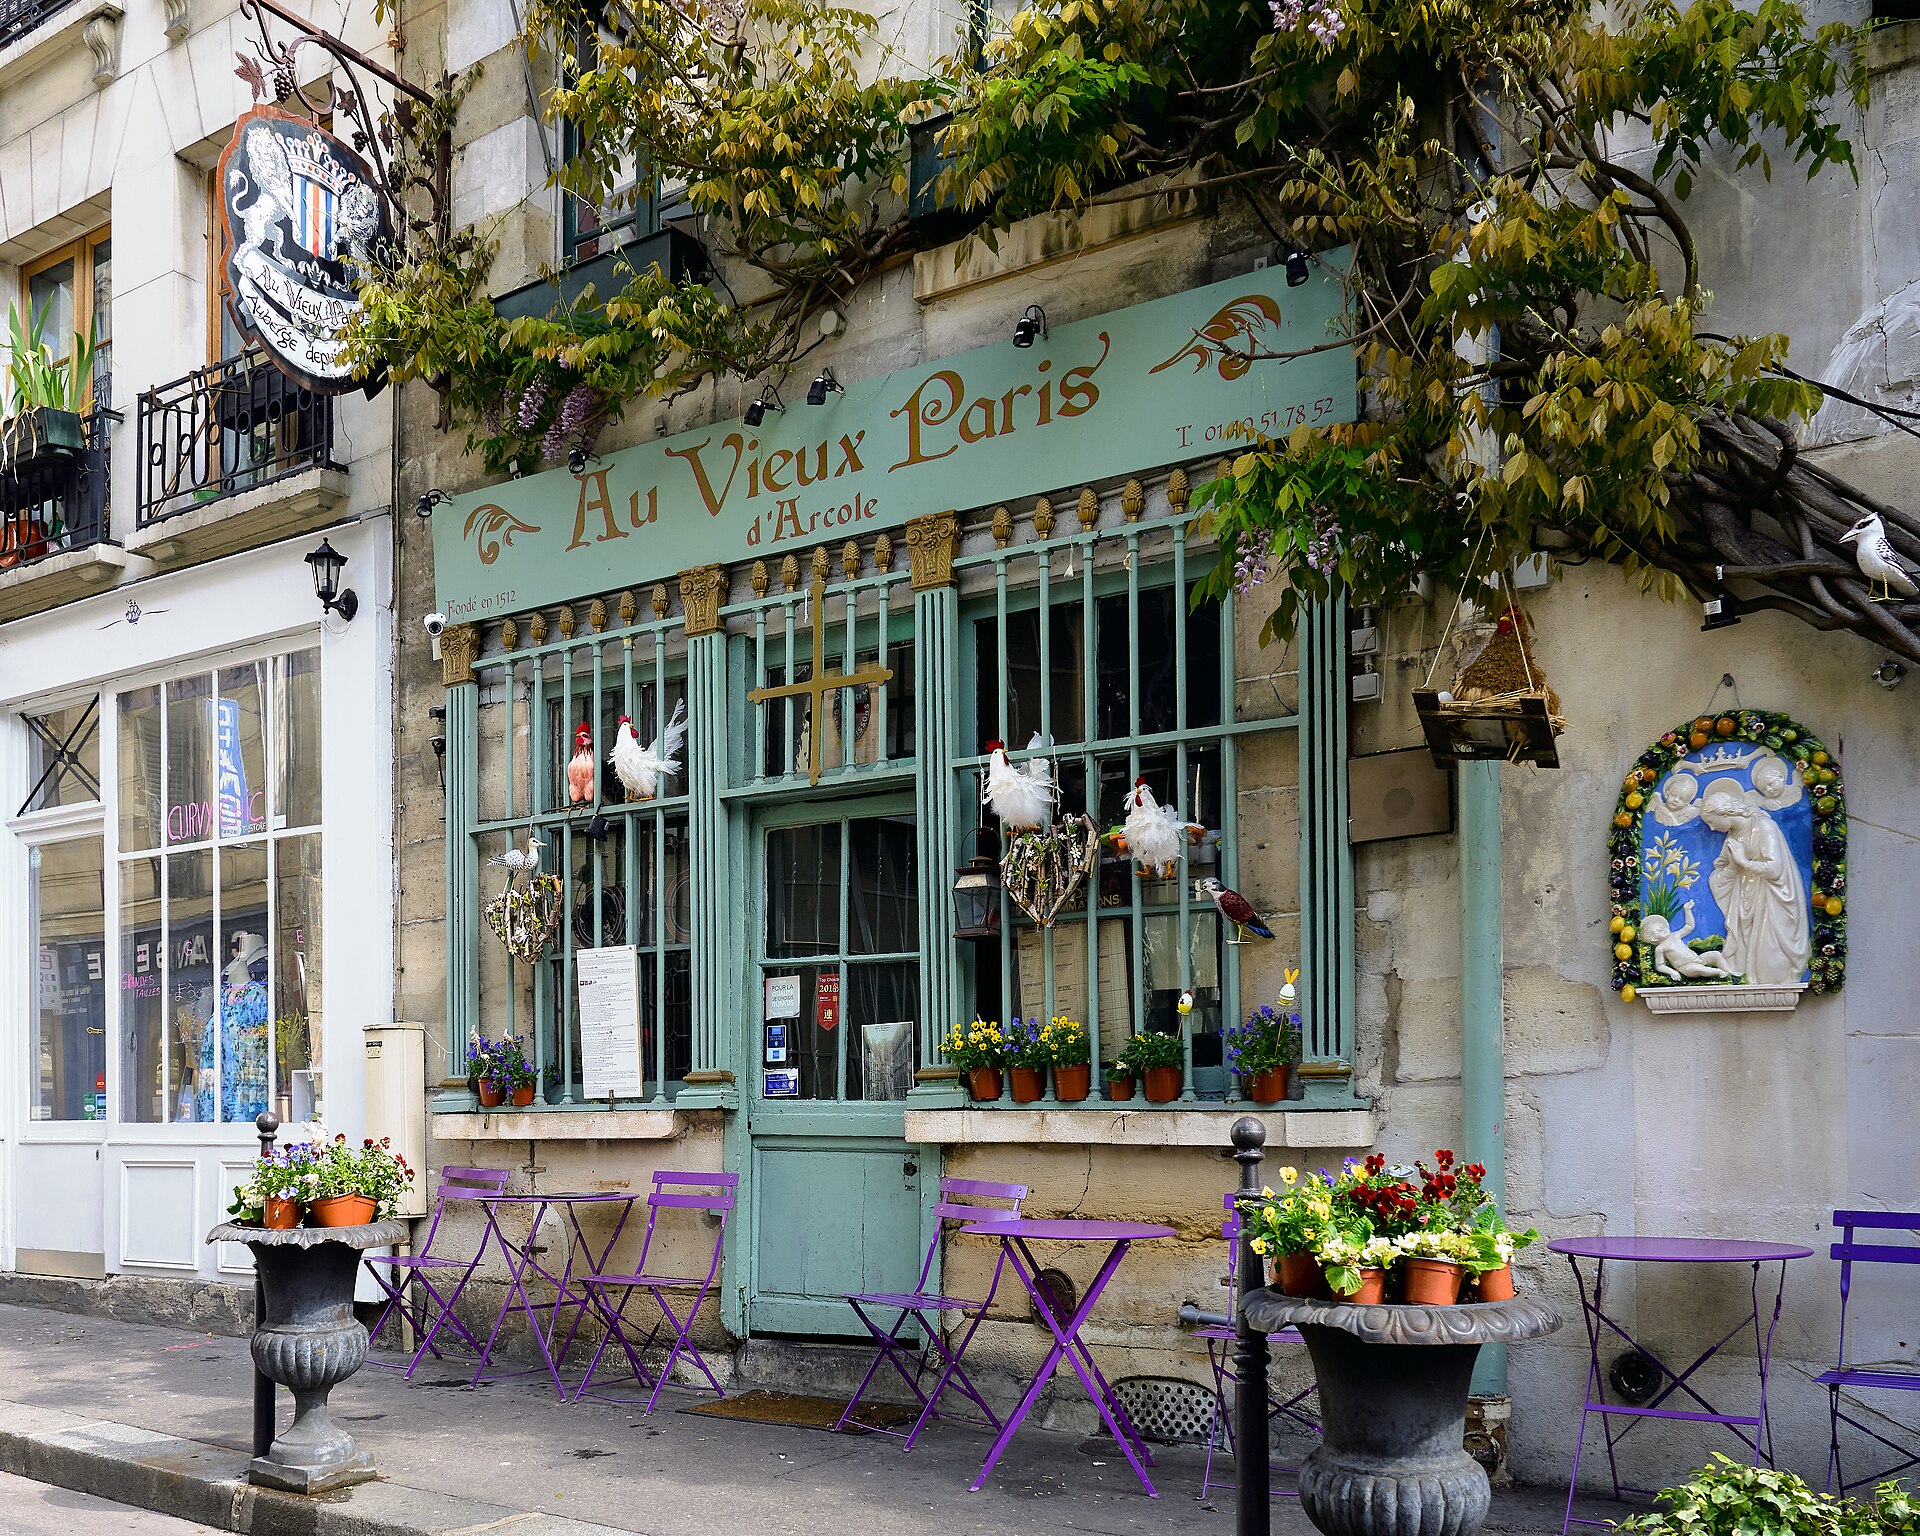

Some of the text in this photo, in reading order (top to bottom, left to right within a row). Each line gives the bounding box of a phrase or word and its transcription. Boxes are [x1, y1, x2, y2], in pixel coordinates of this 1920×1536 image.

[1204, 423, 1223, 441] 01
[1260, 409, 1278, 434] 51
[1284, 404, 1307, 428] 78
[1311, 397, 1334, 422] 52
[564, 331, 1110, 553] Au Vieux Paris
[745, 491, 879, 547] d'Arcole
[445, 590, 516, 622] Fondé en 1512
[168, 800, 214, 840] CURVY
[135, 987, 161, 999] TAILLES
